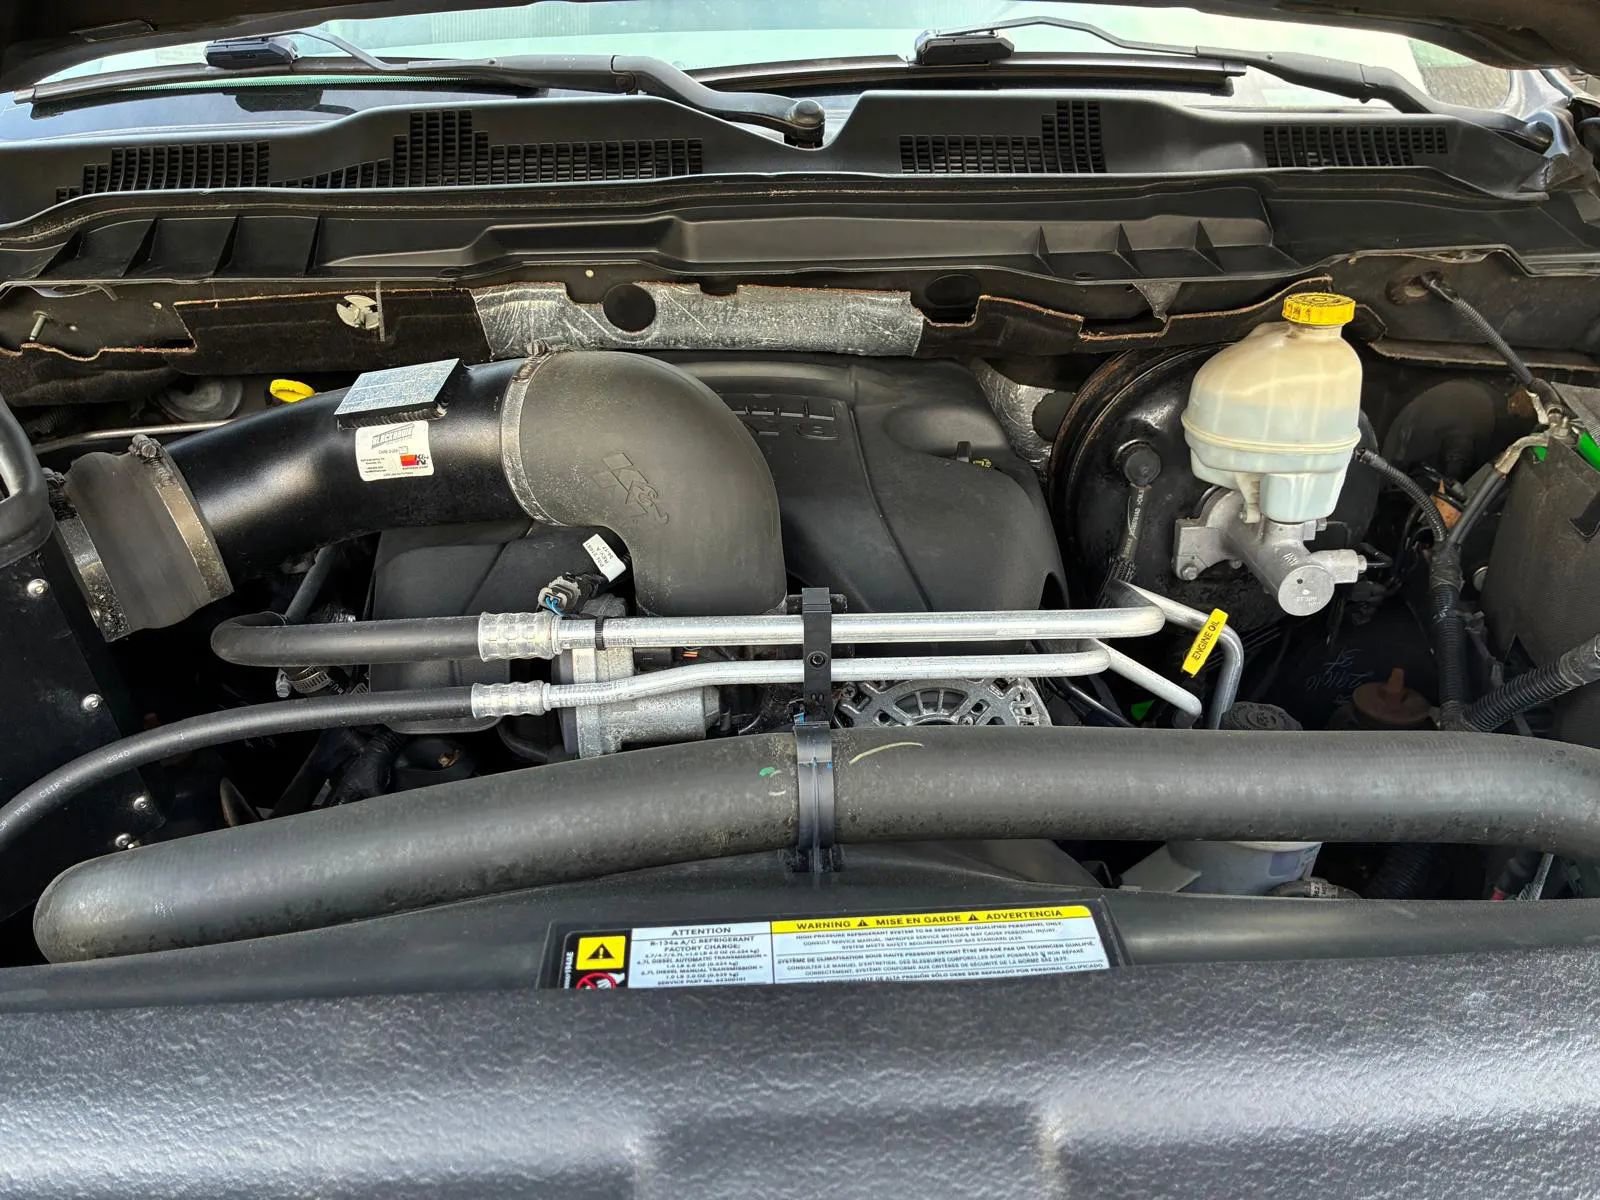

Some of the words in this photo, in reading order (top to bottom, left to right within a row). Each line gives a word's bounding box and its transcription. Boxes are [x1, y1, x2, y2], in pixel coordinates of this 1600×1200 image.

[1191, 631, 1213, 660] ENGINE
[1208, 621, 1219, 632] OIL
[797, 921, 851, 930] WARNING
[876, 918, 904, 926] MISE
[924, 915, 961, 923] GARDE
[987, 910, 1063, 920] ADVERTENCIA
[672, 927, 731, 936] ATTENTION
[699, 936, 755, 944] REFRIGERANT
